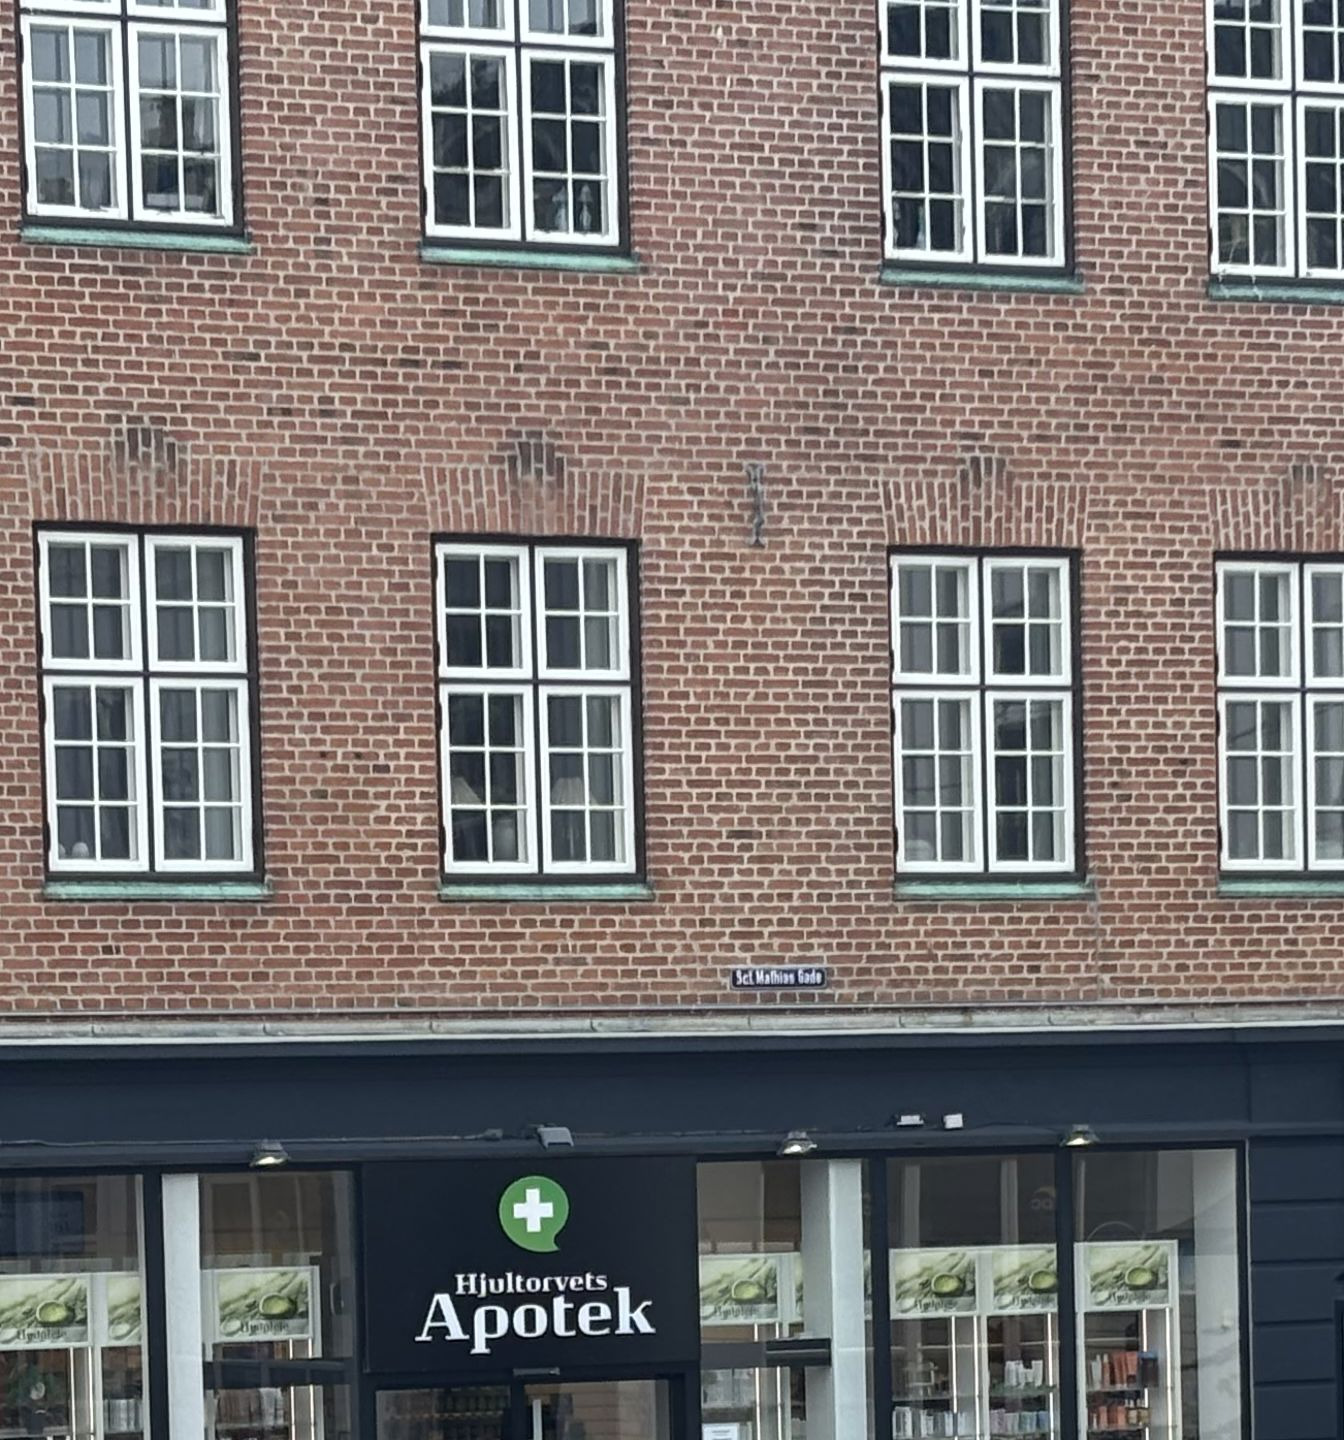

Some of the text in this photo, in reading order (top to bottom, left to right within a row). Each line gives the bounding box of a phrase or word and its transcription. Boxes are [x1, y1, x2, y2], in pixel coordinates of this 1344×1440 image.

[797, 968, 822, 984] Gade
[454, 1271, 608, 1298] Hjultorvets
[414, 1286, 656, 1354] Apotek
